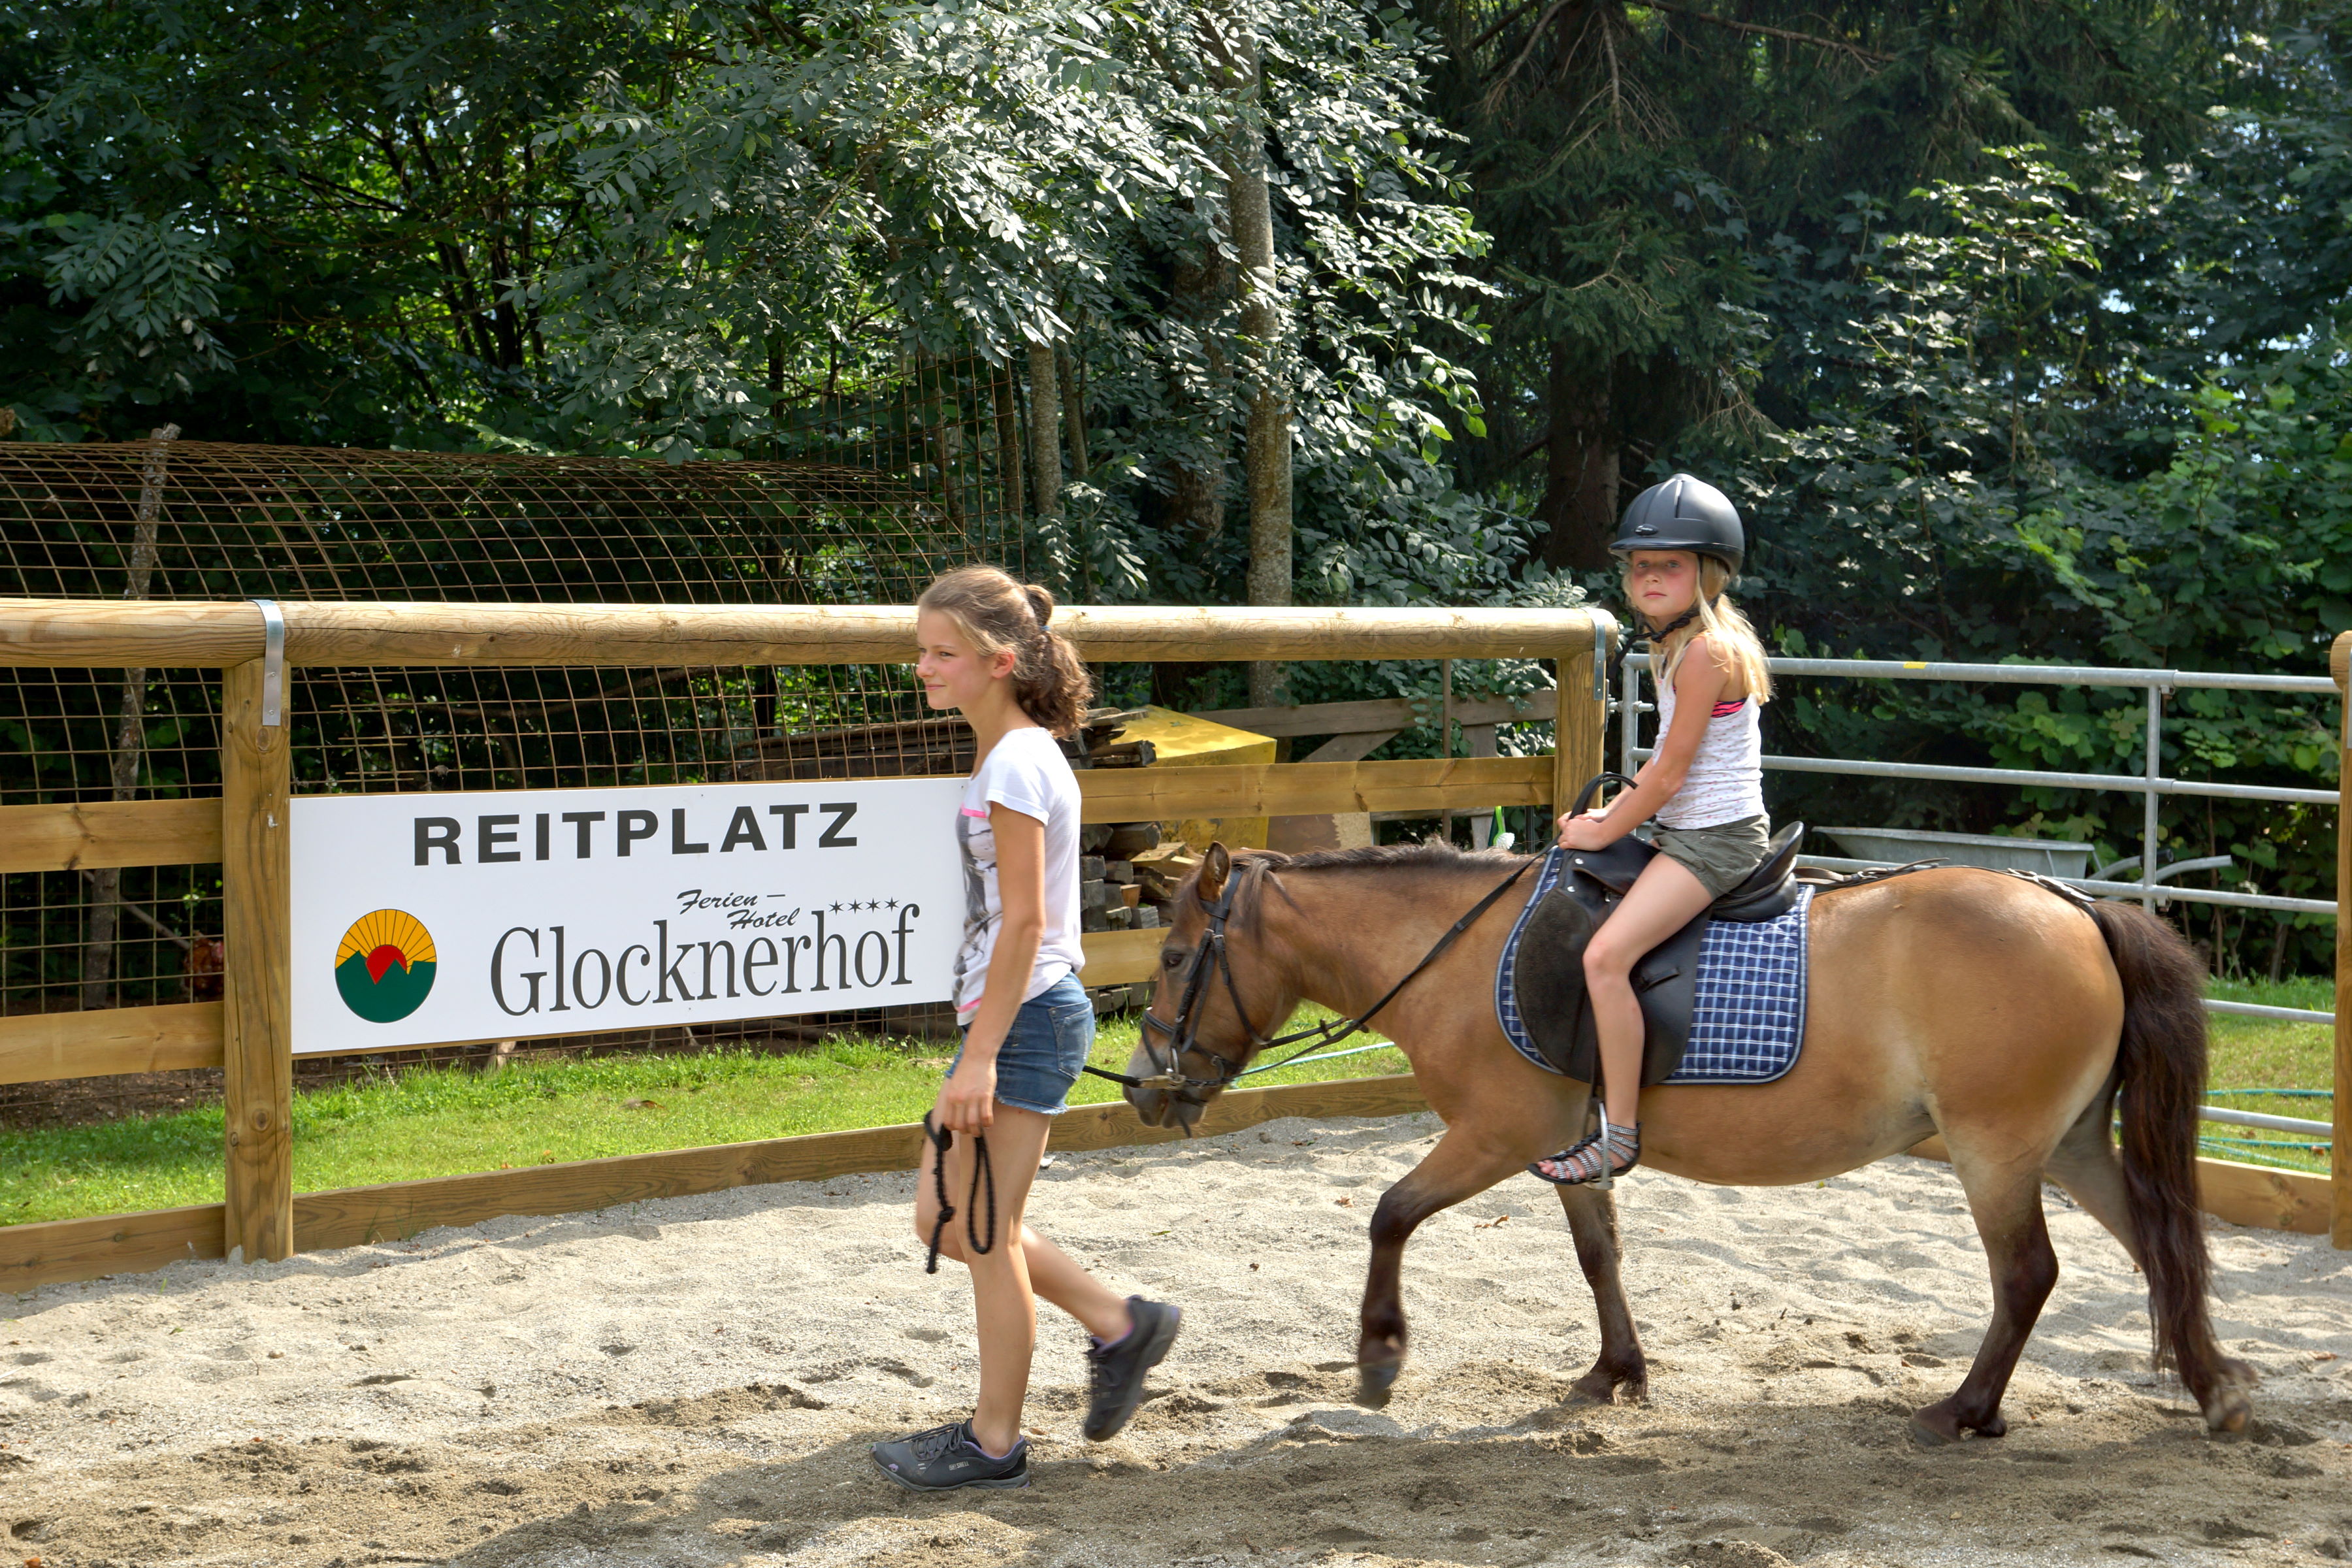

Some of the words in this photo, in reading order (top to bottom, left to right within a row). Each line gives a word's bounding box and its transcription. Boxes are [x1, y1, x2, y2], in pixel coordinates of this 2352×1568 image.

[414, 802, 858, 866] REITPLATZ
[727, 907, 800, 930] Hotel
[491, 903, 920, 1016] Glocknerhof
